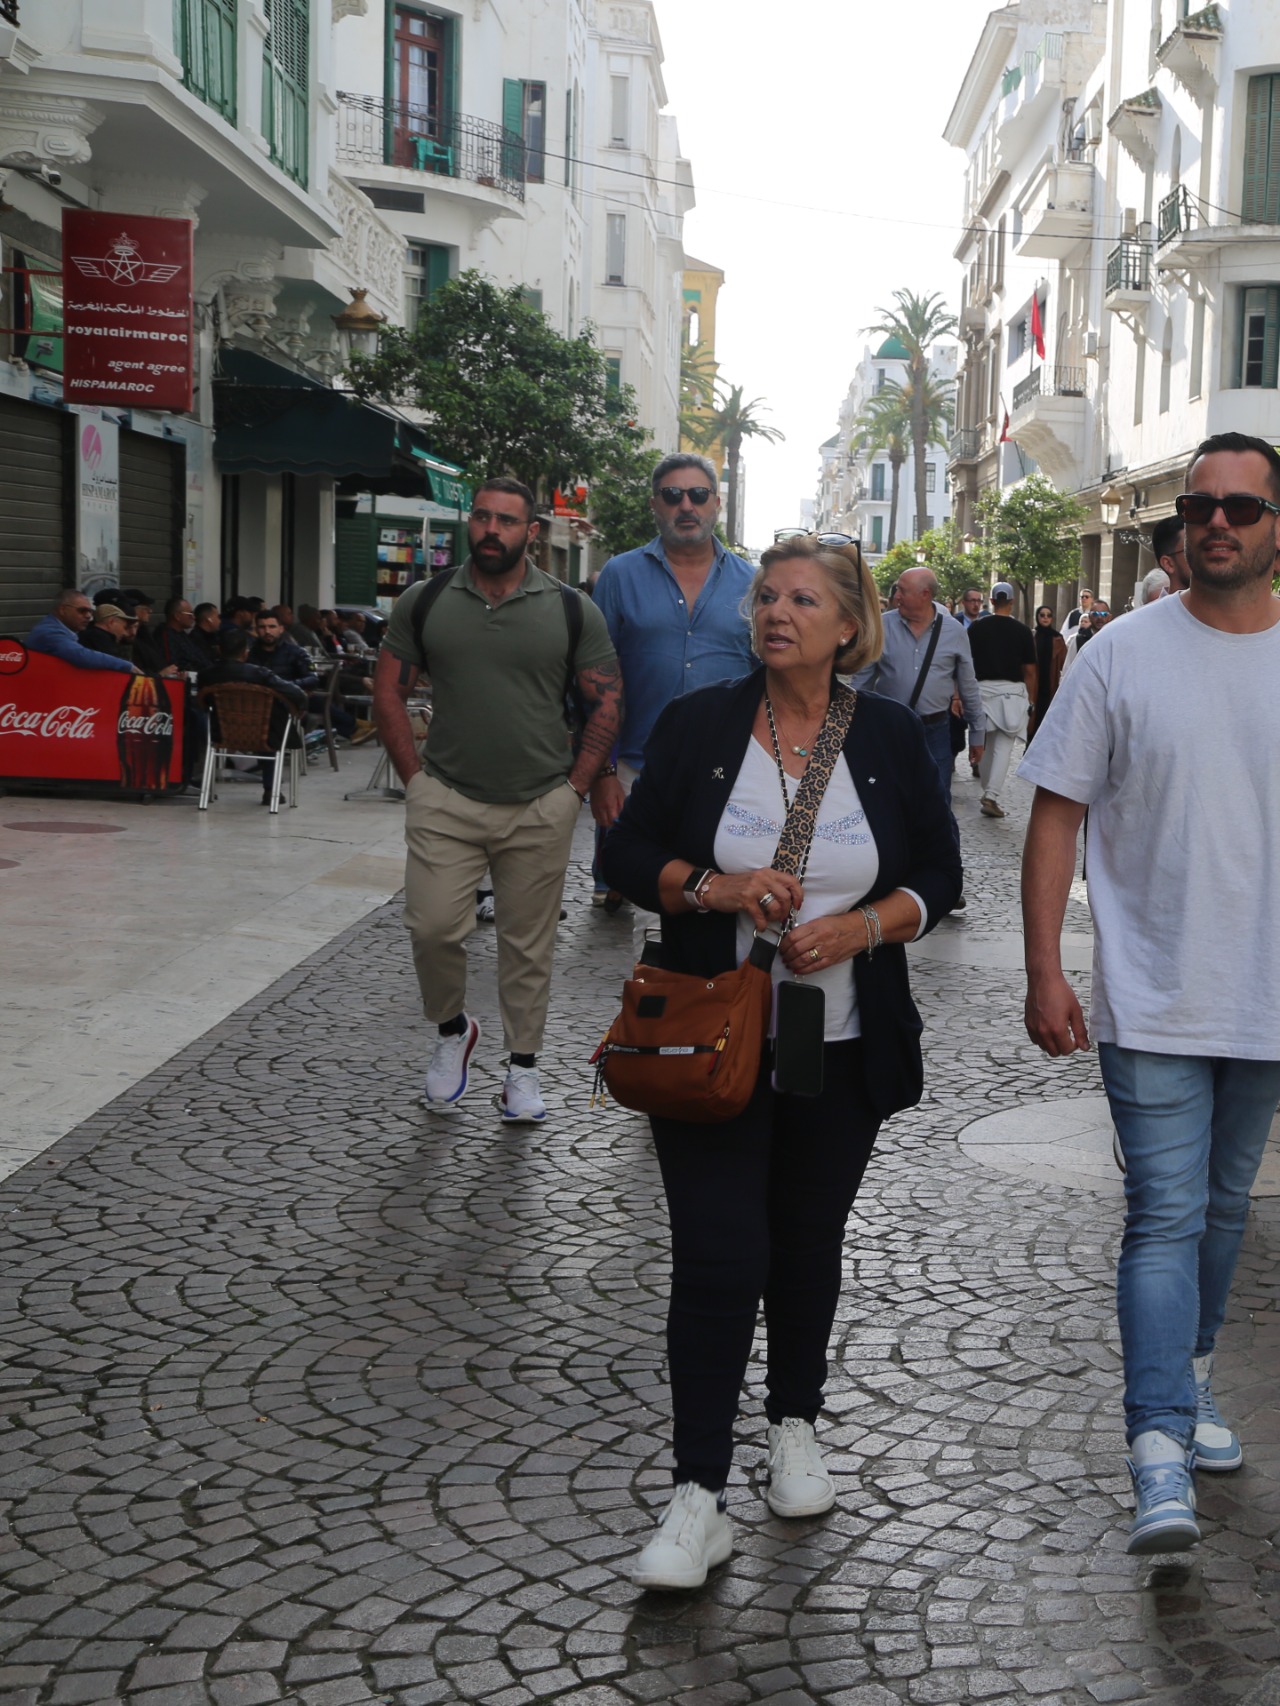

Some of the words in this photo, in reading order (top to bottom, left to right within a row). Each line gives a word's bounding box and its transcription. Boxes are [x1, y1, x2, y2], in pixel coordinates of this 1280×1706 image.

[68, 325, 187, 344] royalairmaroc
[107, 360, 144, 372] agent
[70, 379, 155, 393] HISPAMAROC
[118, 711, 173, 735] Coca-Cola
